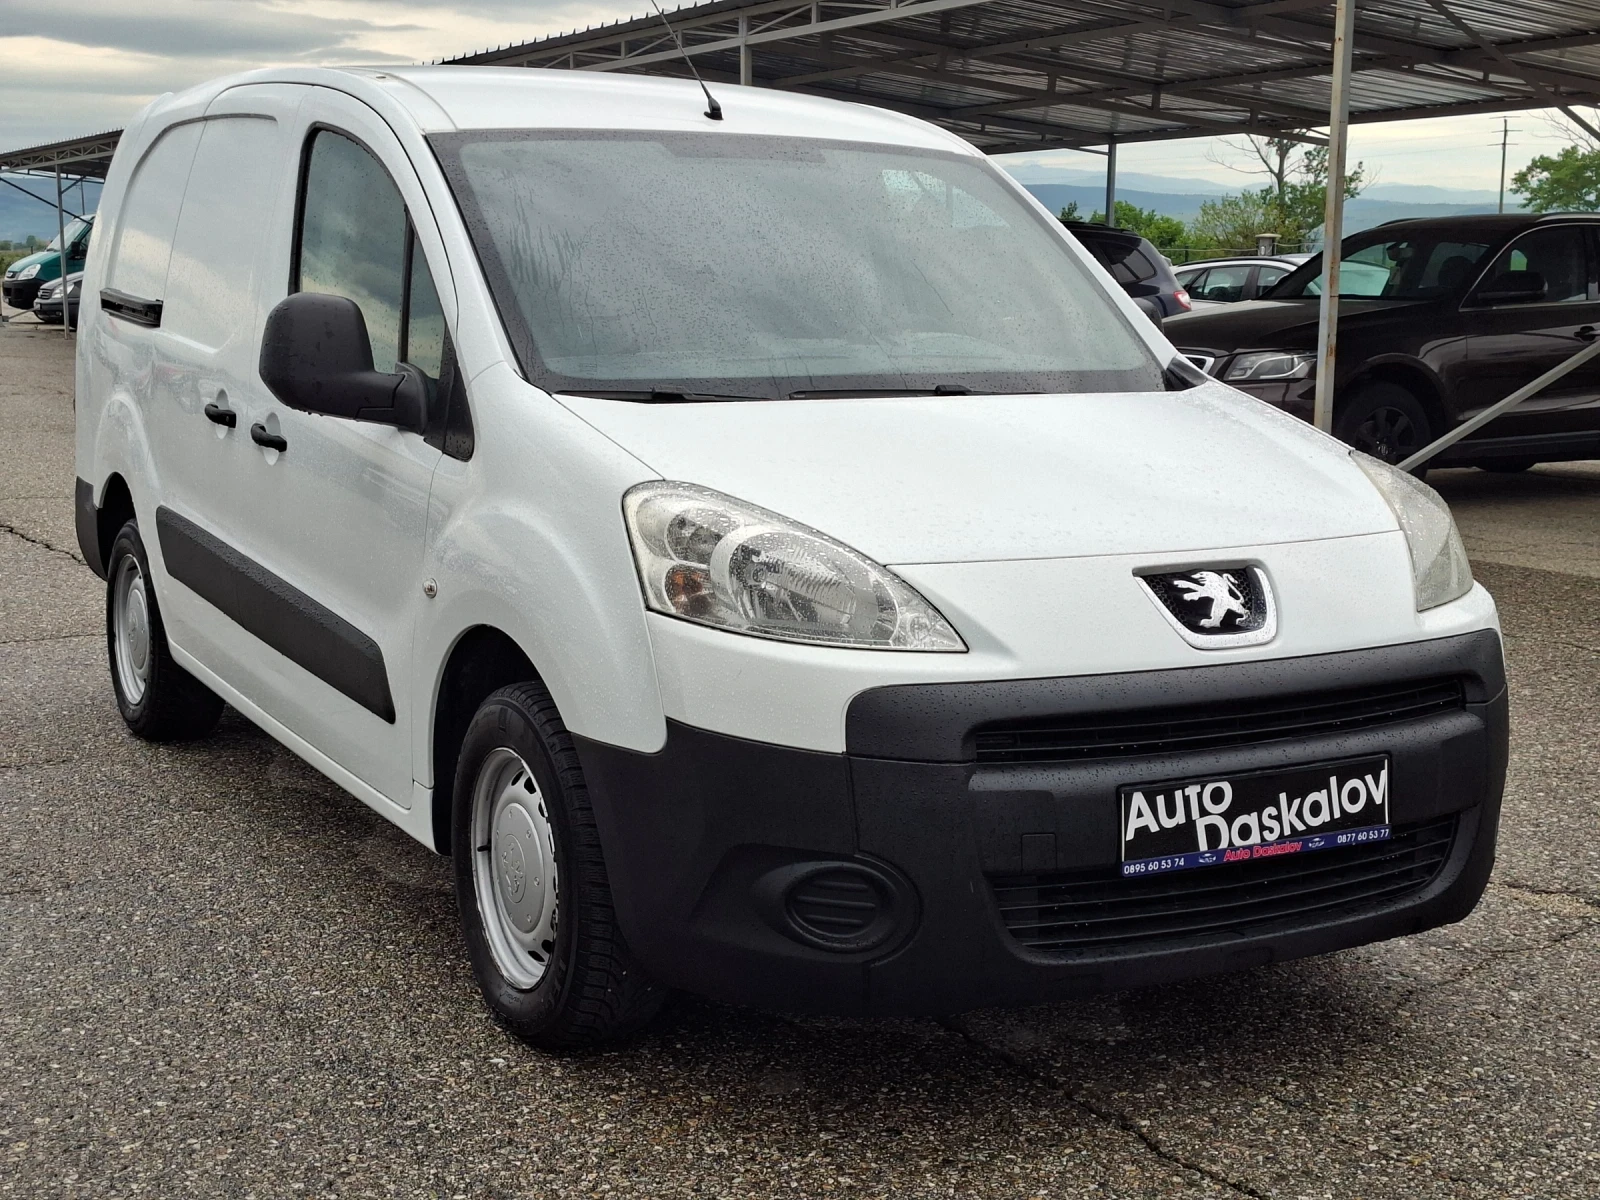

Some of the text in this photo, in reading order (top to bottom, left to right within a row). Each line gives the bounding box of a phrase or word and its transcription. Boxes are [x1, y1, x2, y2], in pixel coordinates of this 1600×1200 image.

[1196, 769, 1386, 851] Daskalov
[1337, 828, 1390, 844] 0877 60 53 77
[1223, 841, 1303, 861] Auto Daskalov
[1124, 857, 1185, 874] 0895 60 53 74
